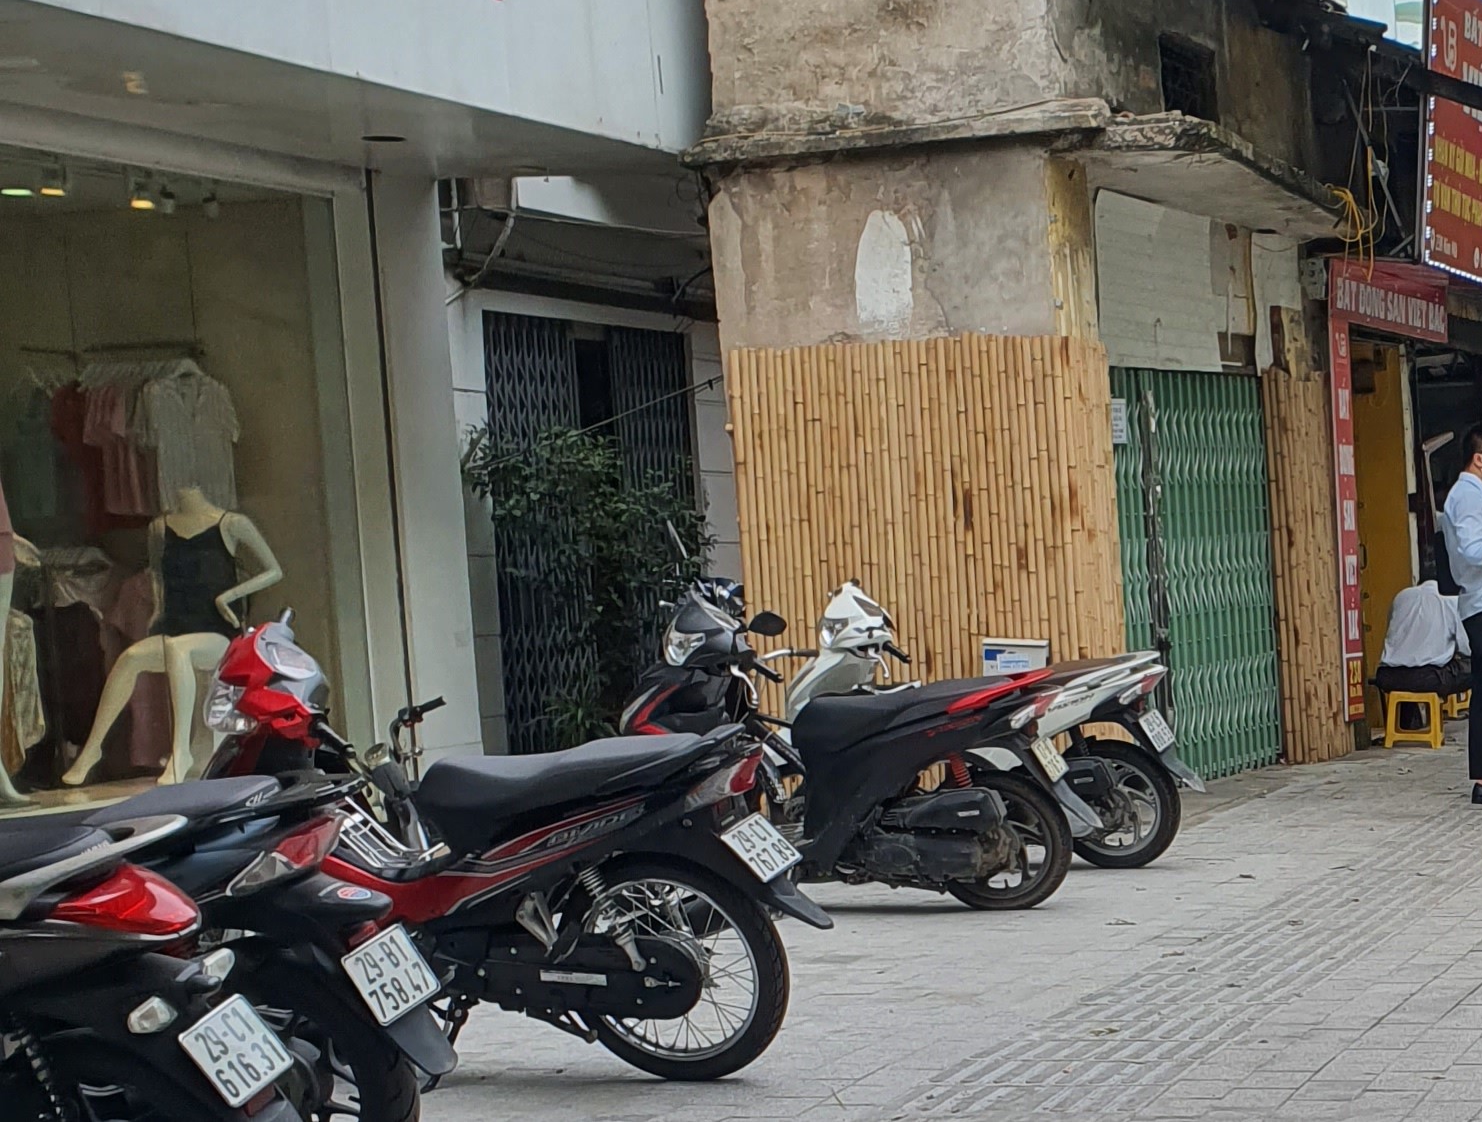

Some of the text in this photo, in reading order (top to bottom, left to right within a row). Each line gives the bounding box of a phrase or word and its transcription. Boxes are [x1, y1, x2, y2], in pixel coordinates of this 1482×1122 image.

[1336, 268, 1357, 312] BẤT
[1358, 281, 1386, 322] ĐỘNG
[1386, 284, 1406, 325] SẢN
[1407, 292, 1428, 334] VIỆT
[748, 838, 797, 878] 767.89
[368, 961, 430, 1020] 758.47
[215, 1033, 286, 1098] 616.31
